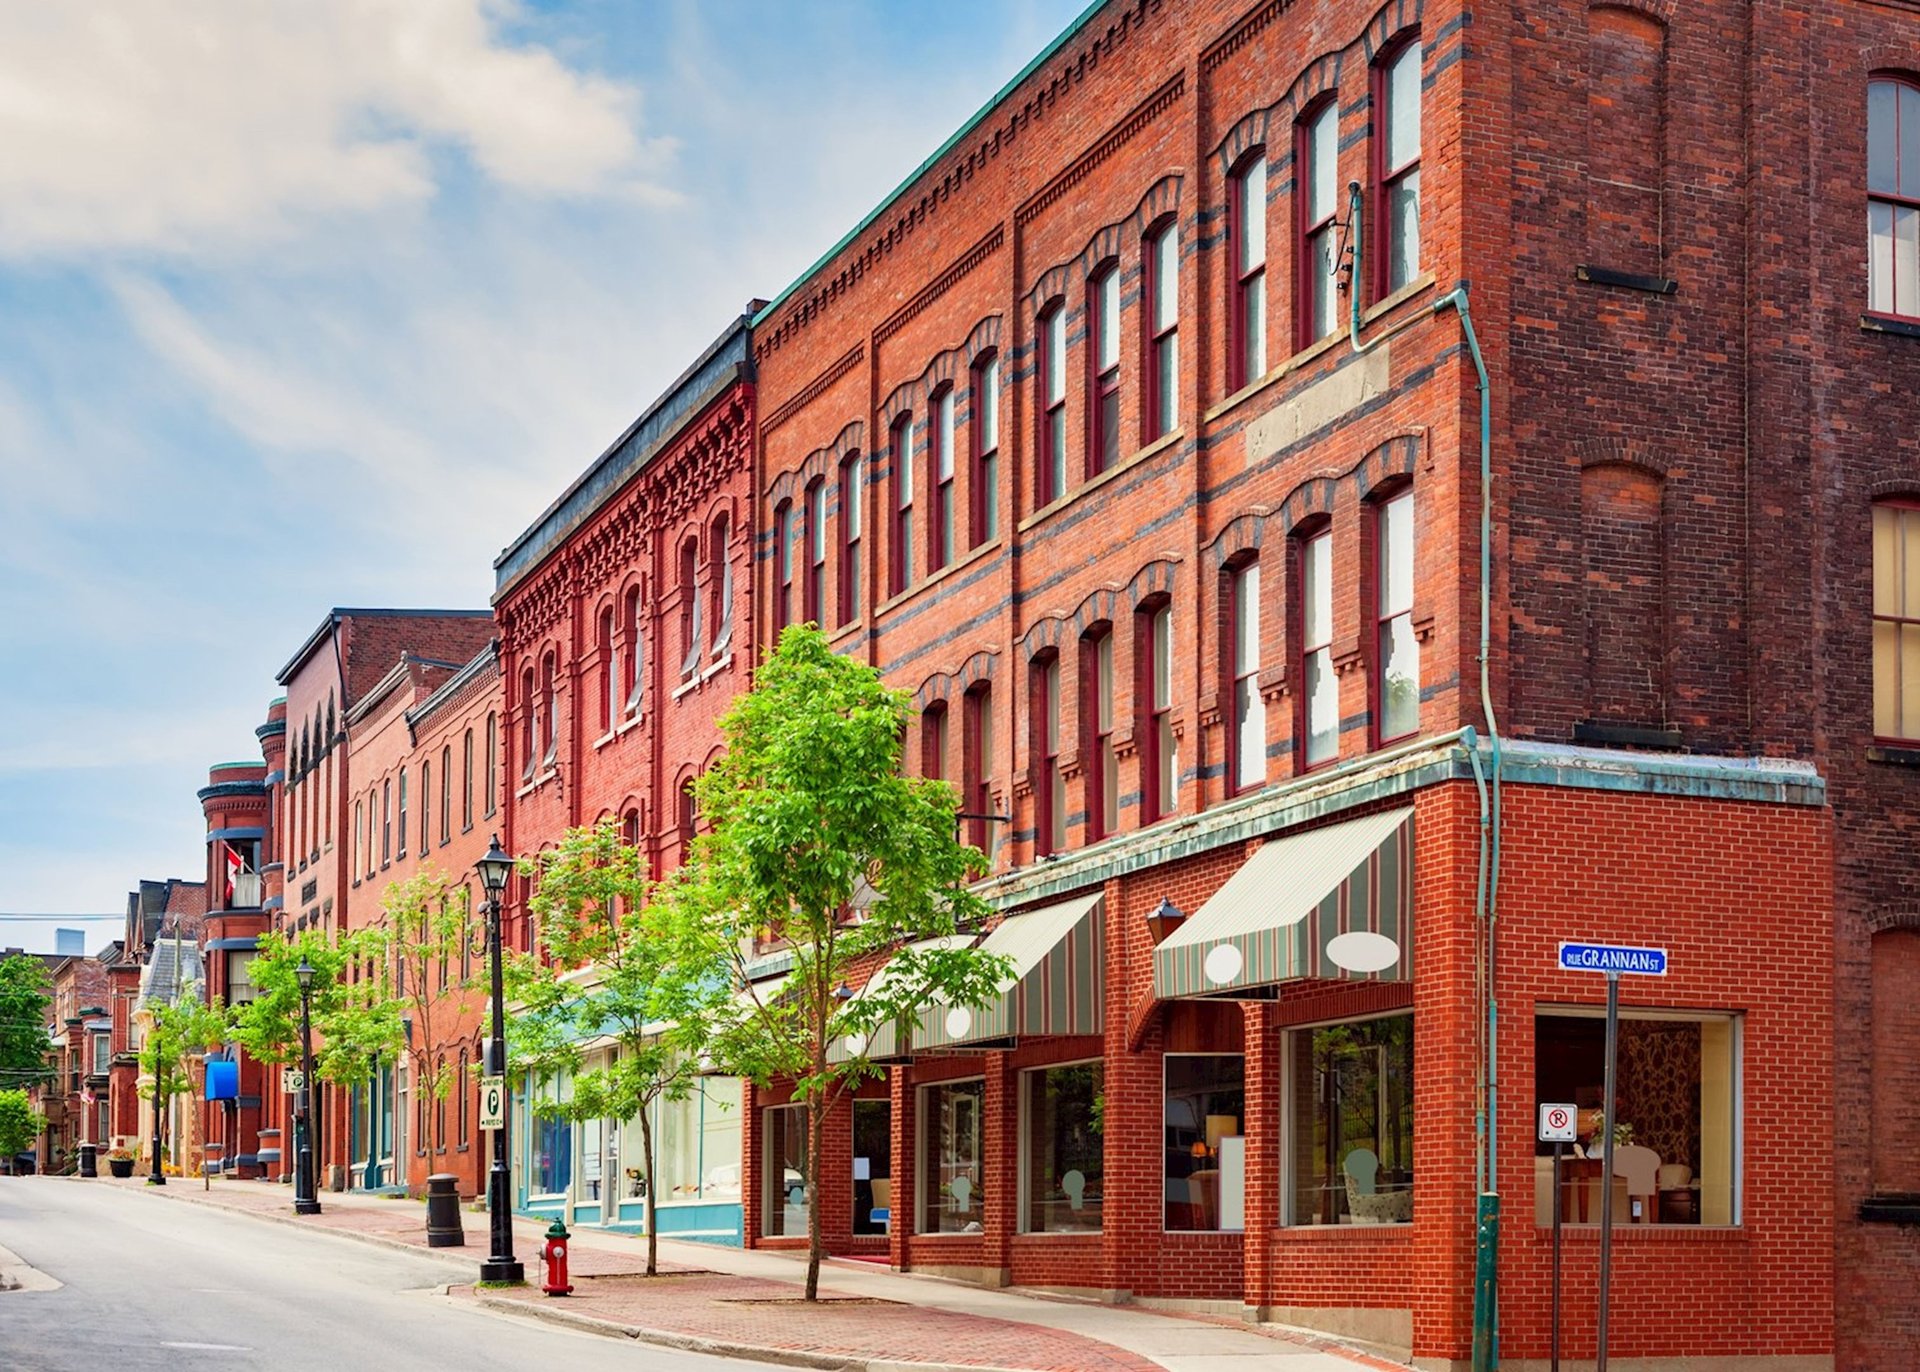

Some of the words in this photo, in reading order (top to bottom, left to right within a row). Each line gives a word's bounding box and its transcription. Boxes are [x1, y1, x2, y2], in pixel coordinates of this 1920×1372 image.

[1566, 953, 1581, 965] RUE
[1582, 949, 1650, 970] GRANNAN
[1650, 960, 1659, 970] ST
